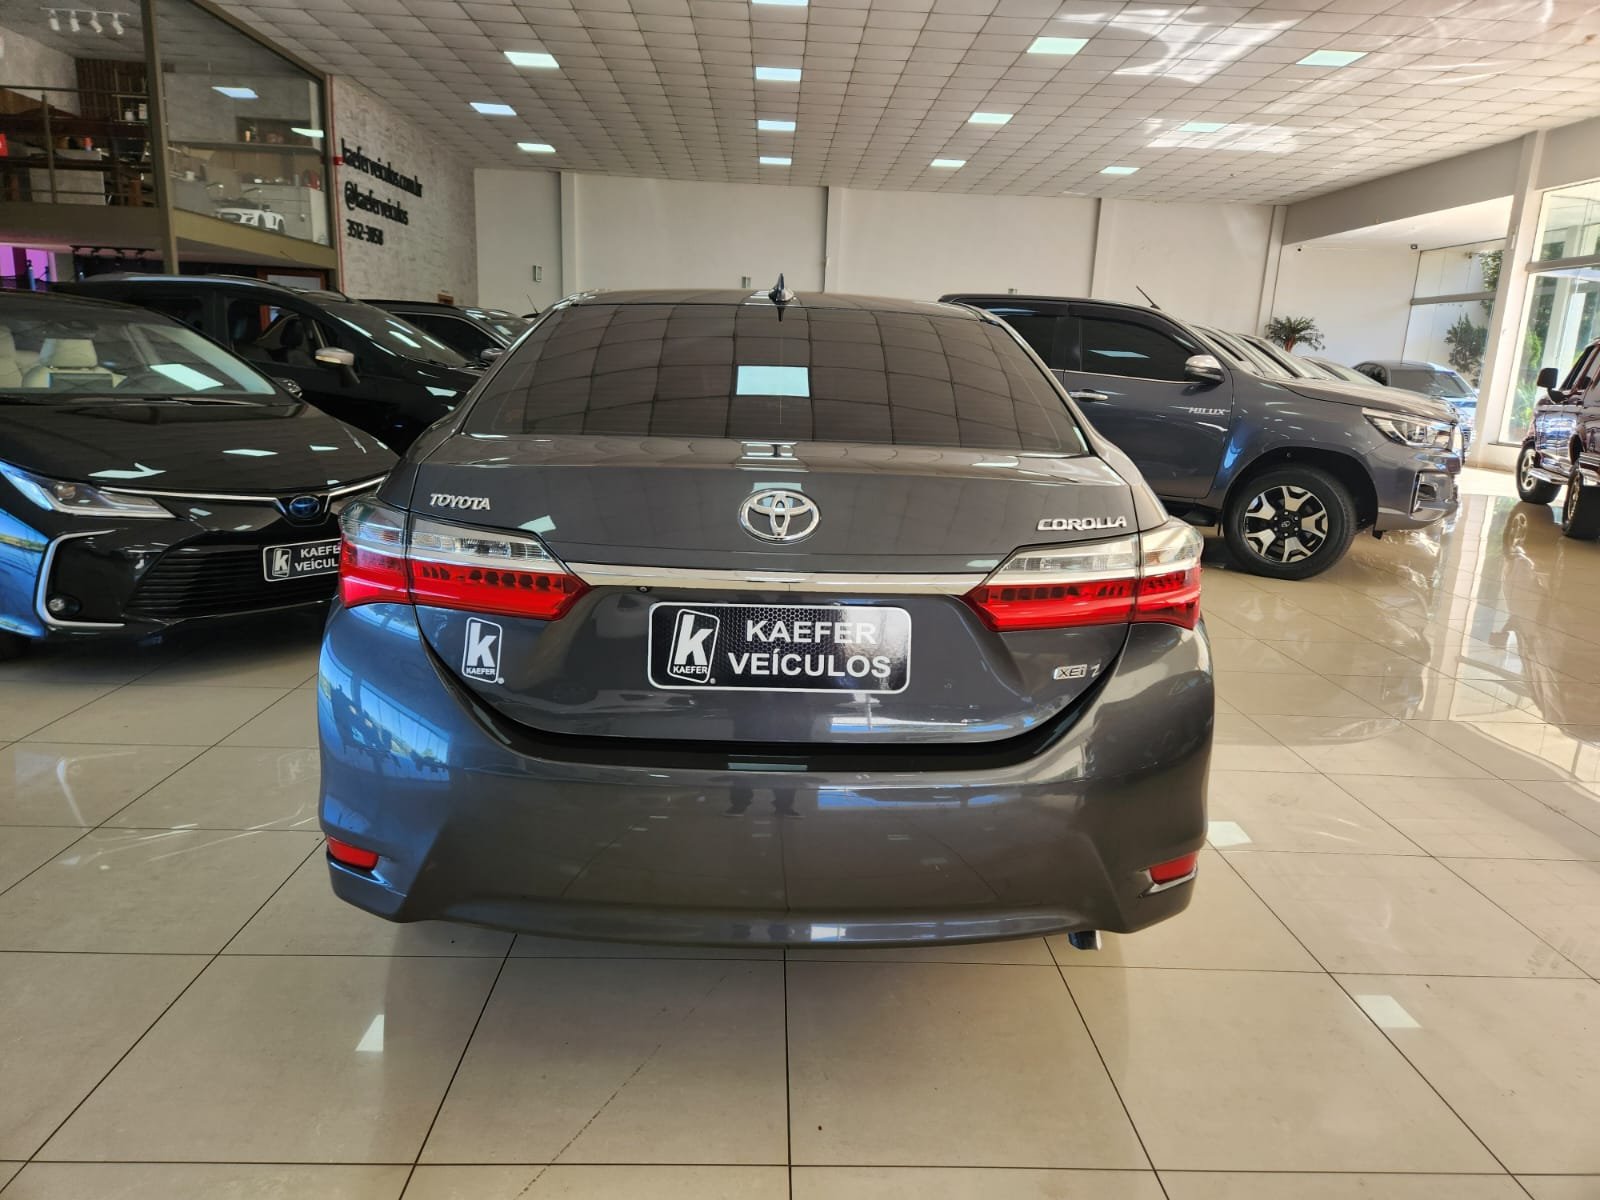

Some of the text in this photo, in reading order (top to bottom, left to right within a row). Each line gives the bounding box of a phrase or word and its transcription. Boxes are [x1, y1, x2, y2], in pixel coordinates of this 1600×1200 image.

[429, 493, 491, 511] TOYOTA
[1037, 515, 1127, 531] COROLLA
[300, 544, 341, 559] KAEFE
[294, 558, 339, 571] VEÍCUL
[746, 619, 877, 645] KAEFER
[673, 665, 709, 675] KAEFER
[727, 648, 892, 678] VEÍCULOS
[466, 667, 496, 676] KAEFER
